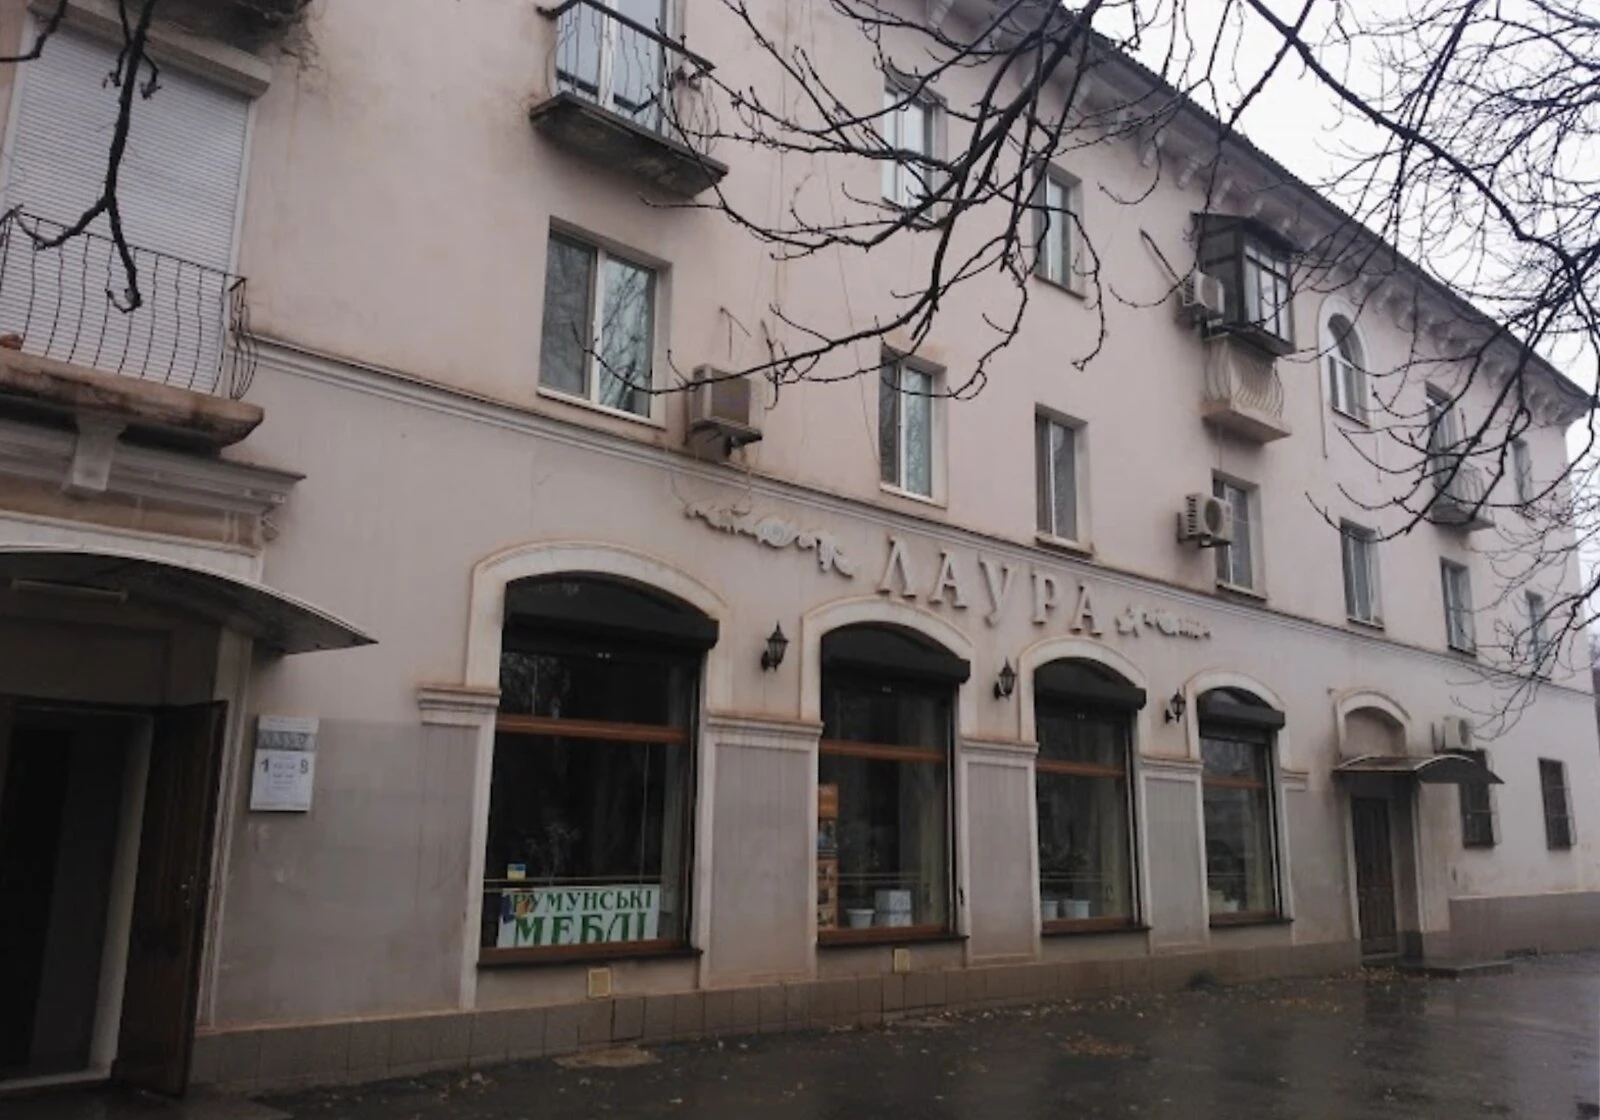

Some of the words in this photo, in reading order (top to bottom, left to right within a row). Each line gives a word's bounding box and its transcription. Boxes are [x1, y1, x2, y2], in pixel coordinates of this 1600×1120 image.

[875, 537, 1102, 636] ЛАУРА
[512, 890, 652, 915] РУМУНСЬКІ
[514, 912, 648, 947] МЕБЛІ
